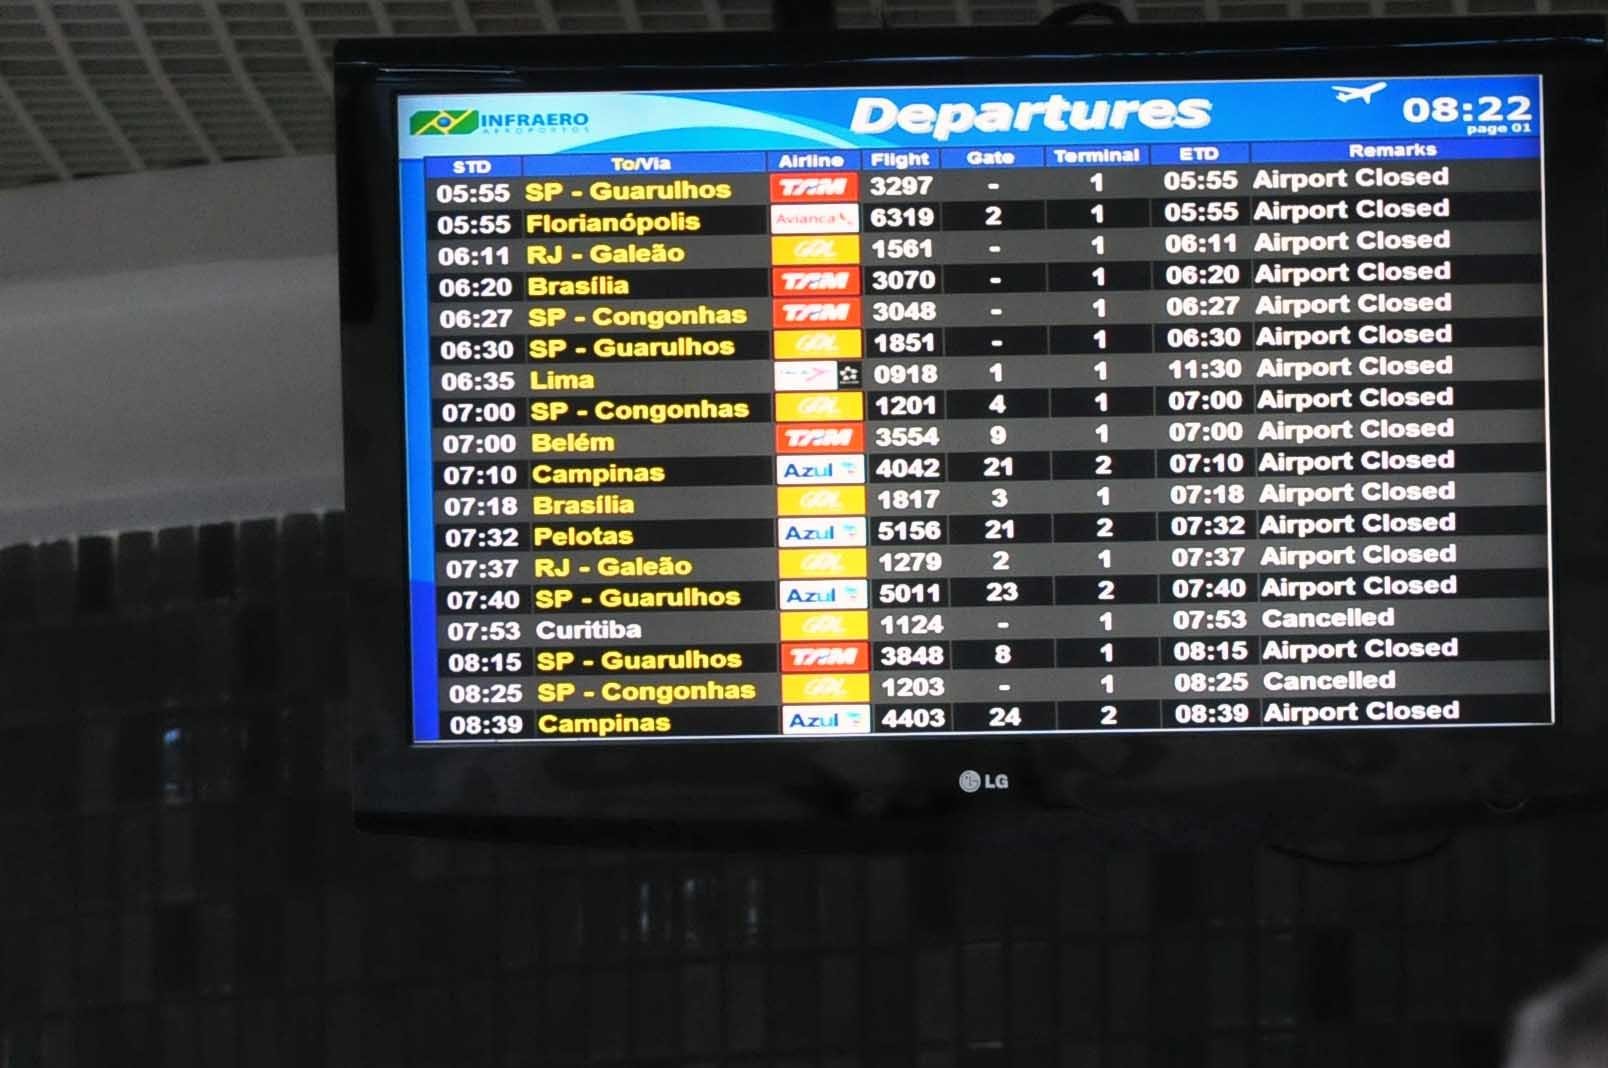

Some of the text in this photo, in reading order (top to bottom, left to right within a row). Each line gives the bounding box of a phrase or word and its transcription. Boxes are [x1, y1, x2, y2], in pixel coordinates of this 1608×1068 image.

[850, 93, 1213, 140] Departures
[1402, 95, 1533, 123] 08:22
[481, 112, 590, 128] INFRAERO
[1467, 122, 1531, 136] page 01
[870, 151, 930, 169] Flight
[966, 150, 1016, 166] Gate
[1053, 147, 1141, 164] Terminal
[1179, 146, 1220, 161] ETD
[1349, 142, 1438, 158] Remarks
[453, 159, 492, 174] STD
[610, 156, 672, 172] To/Via
[778, 153, 845, 169] Airline
[436, 183, 511, 204] 05:55
[524, 179, 733, 203] SP Guarulhos
[869, 175, 934, 197] 3297
[1164, 201, 1240, 222] 05:55
[1253, 197, 1450, 225] Airport Closed
[526, 211, 701, 236] Florianópolis
[437, 245, 509, 267] 06:11
[871, 238, 933, 259] 1561
[1165, 264, 1240, 285] 06:20
[527, 275, 630, 296] Brasília
[439, 308, 513, 329] 06:27
[527, 304, 748, 331] SP Congonhas
[872, 300, 937, 322] 3048
[1167, 327, 1242, 348] 06:30
[1255, 323, 1453, 350] Airport Closed
[530, 370, 596, 391] Lima
[873, 363, 939, 385] 0918
[1093, 360, 1108, 381] 1
[441, 371, 516, 392] 06:35
[1168, 390, 1243, 411] 07:00
[442, 433, 517, 454] 07:00
[531, 432, 616, 453] Belém
[875, 426, 941, 448] 3554
[989, 425, 1008, 446] 9
[783, 462, 833, 478] Azul
[983, 456, 1013, 477] 21
[1095, 455, 1113, 475] 2
[1169, 452, 1244, 474] 07:10
[1258, 449, 1455, 476] Airport Closed
[532, 463, 666, 487] Campinas
[444, 496, 519, 517] 07:18
[532, 494, 635, 516] Brasília
[877, 488, 941, 510] 1817
[1171, 515, 1246, 536] 07:32
[534, 526, 634, 547] Pelotas
[445, 558, 520, 579] 07:37
[534, 555, 694, 578] RJ Galeão
[878, 551, 943, 573] 1279
[1172, 578, 1247, 599] 07:40
[1261, 574, 1457, 601] Airport Closed
[880, 614, 945, 635] 1124
[1261, 606, 1396, 629] Cancelled
[447, 621, 522, 642] 07:53
[535, 619, 643, 640] Curitiba
[994, 644, 1012, 664] 8
[1173, 640, 1249, 661] 08:15
[881, 676, 946, 697] 1203
[1262, 669, 1397, 692] Cancelled
[449, 683, 524, 704] 08:25
[989, 706, 1022, 727] 24
[1175, 703, 1250, 724] 08:39
[1263, 700, 1460, 726] Airport Closed
[538, 713, 672, 737] Campinas
